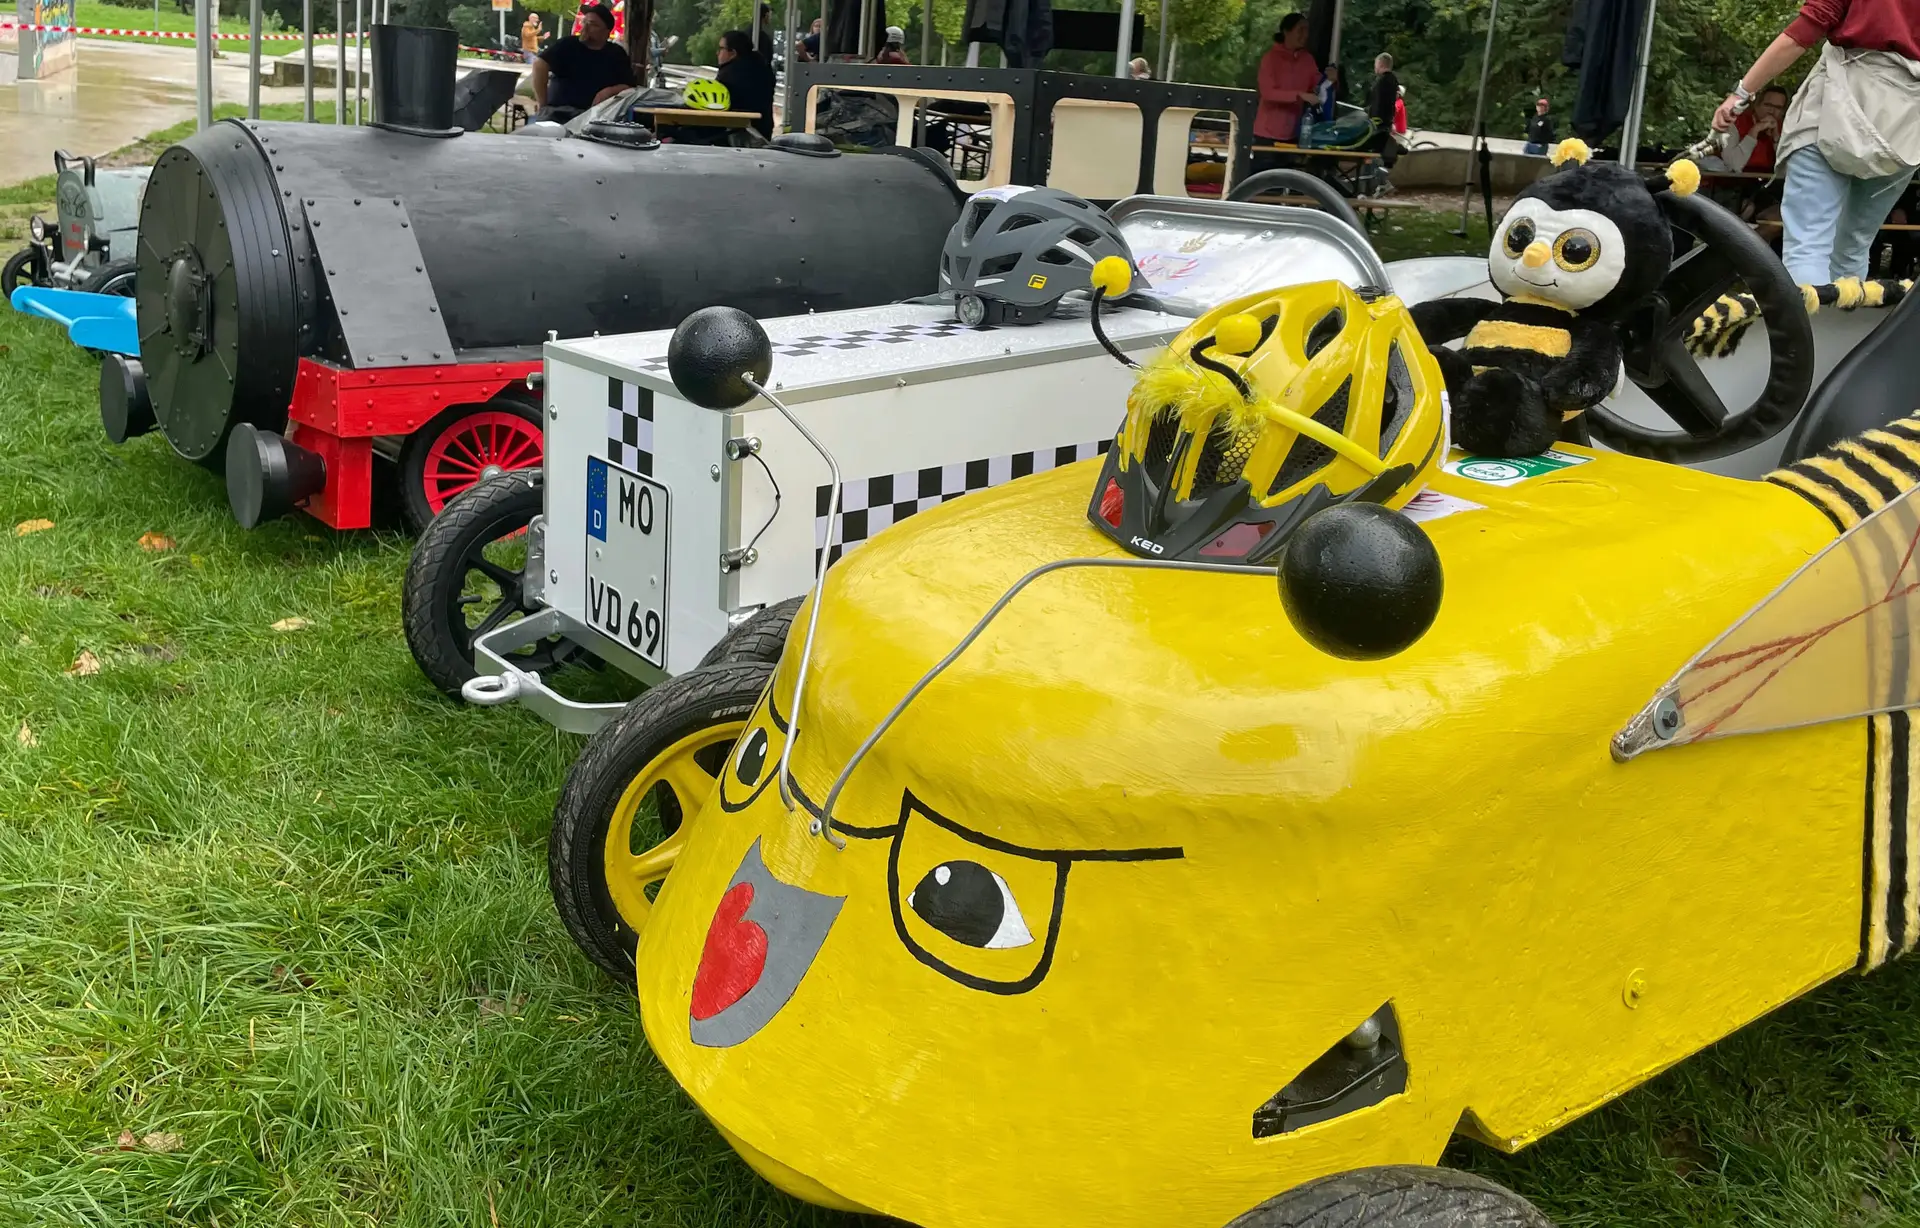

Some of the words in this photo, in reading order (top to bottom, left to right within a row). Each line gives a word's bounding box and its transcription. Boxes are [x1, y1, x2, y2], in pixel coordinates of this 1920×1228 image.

[1464, 466, 1506, 478] DEKRA
[619, 475, 654, 536] MO
[593, 509, 602, 529] D
[1130, 535, 1165, 555] KED
[590, 575, 622, 636] VD
[627, 600, 661, 657] 69
